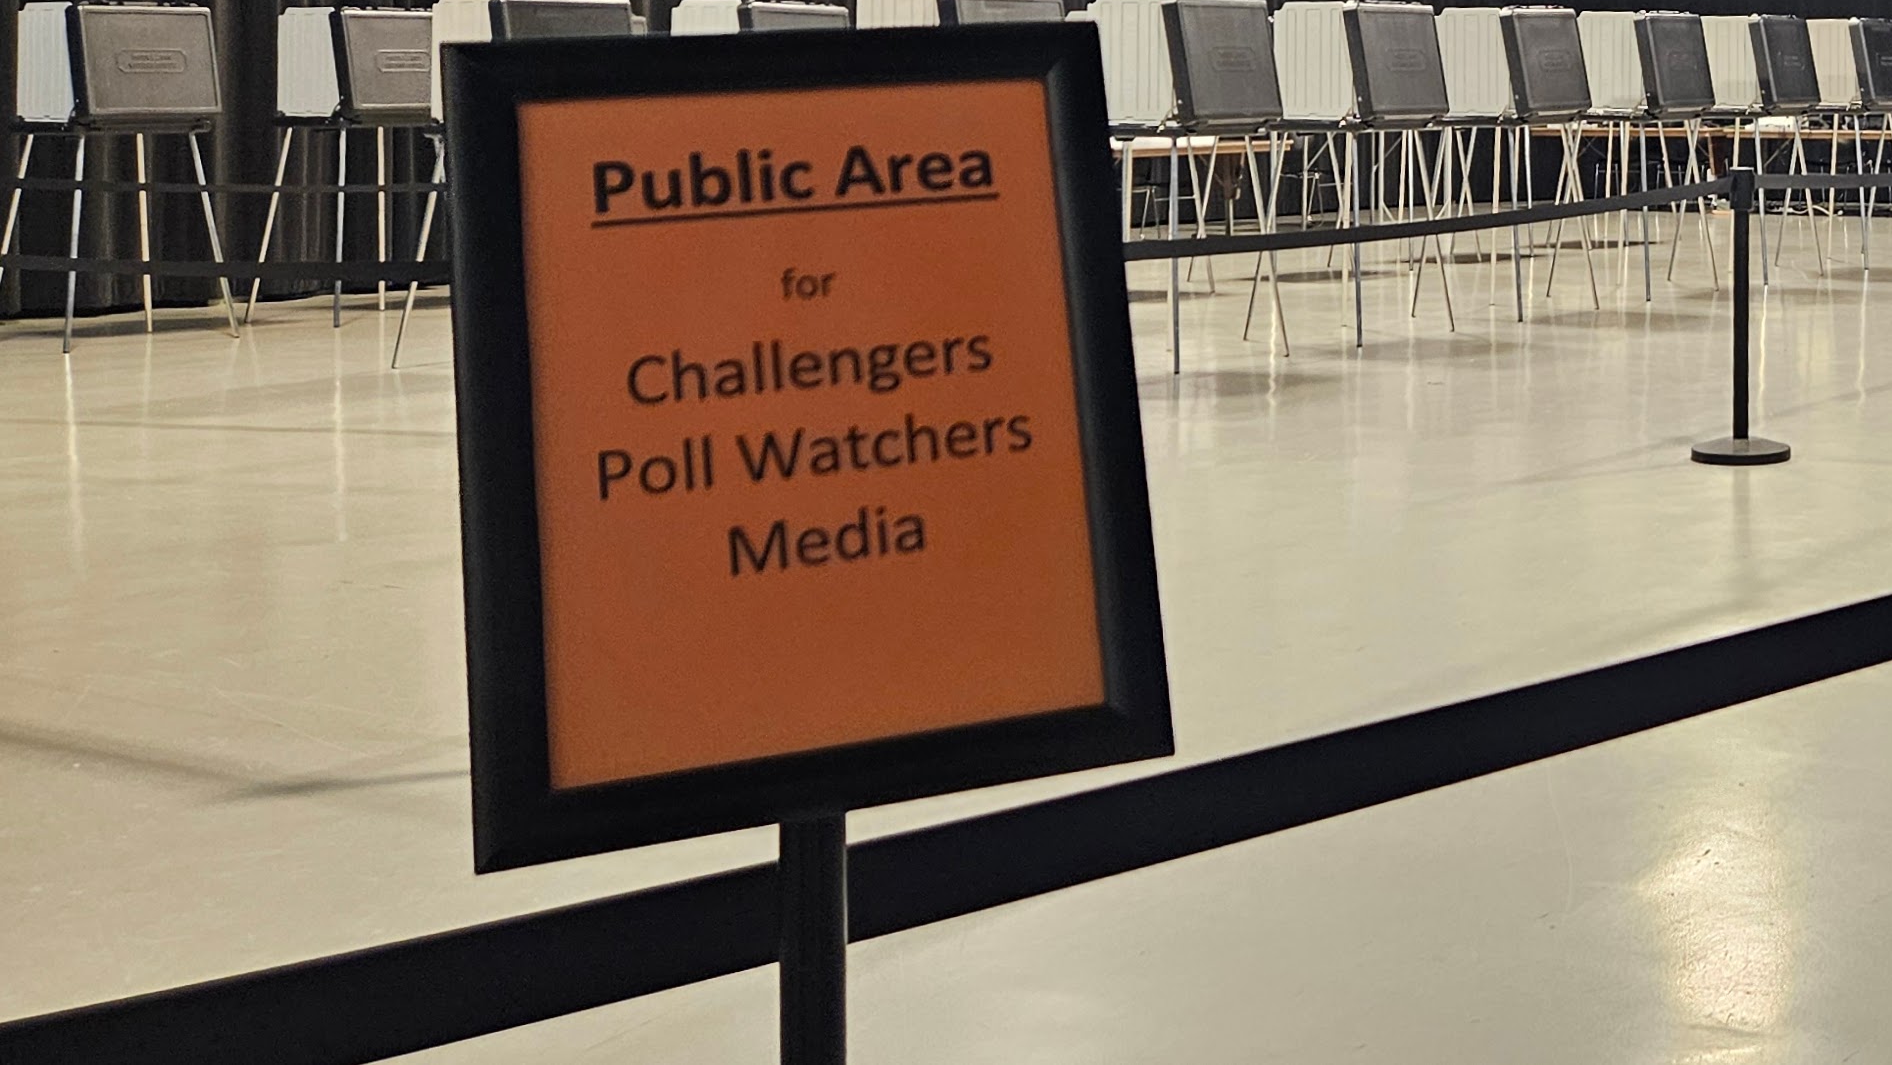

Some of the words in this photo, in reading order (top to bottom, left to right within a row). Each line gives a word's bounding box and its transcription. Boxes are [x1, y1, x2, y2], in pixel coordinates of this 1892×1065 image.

[591, 148, 814, 214] Public
[835, 144, 995, 197] Area
[781, 267, 837, 301] for
[627, 334, 993, 406] Challengers
[598, 438, 714, 501] Poll
[736, 412, 1033, 483] Watchers
[727, 505, 926, 576] Media
